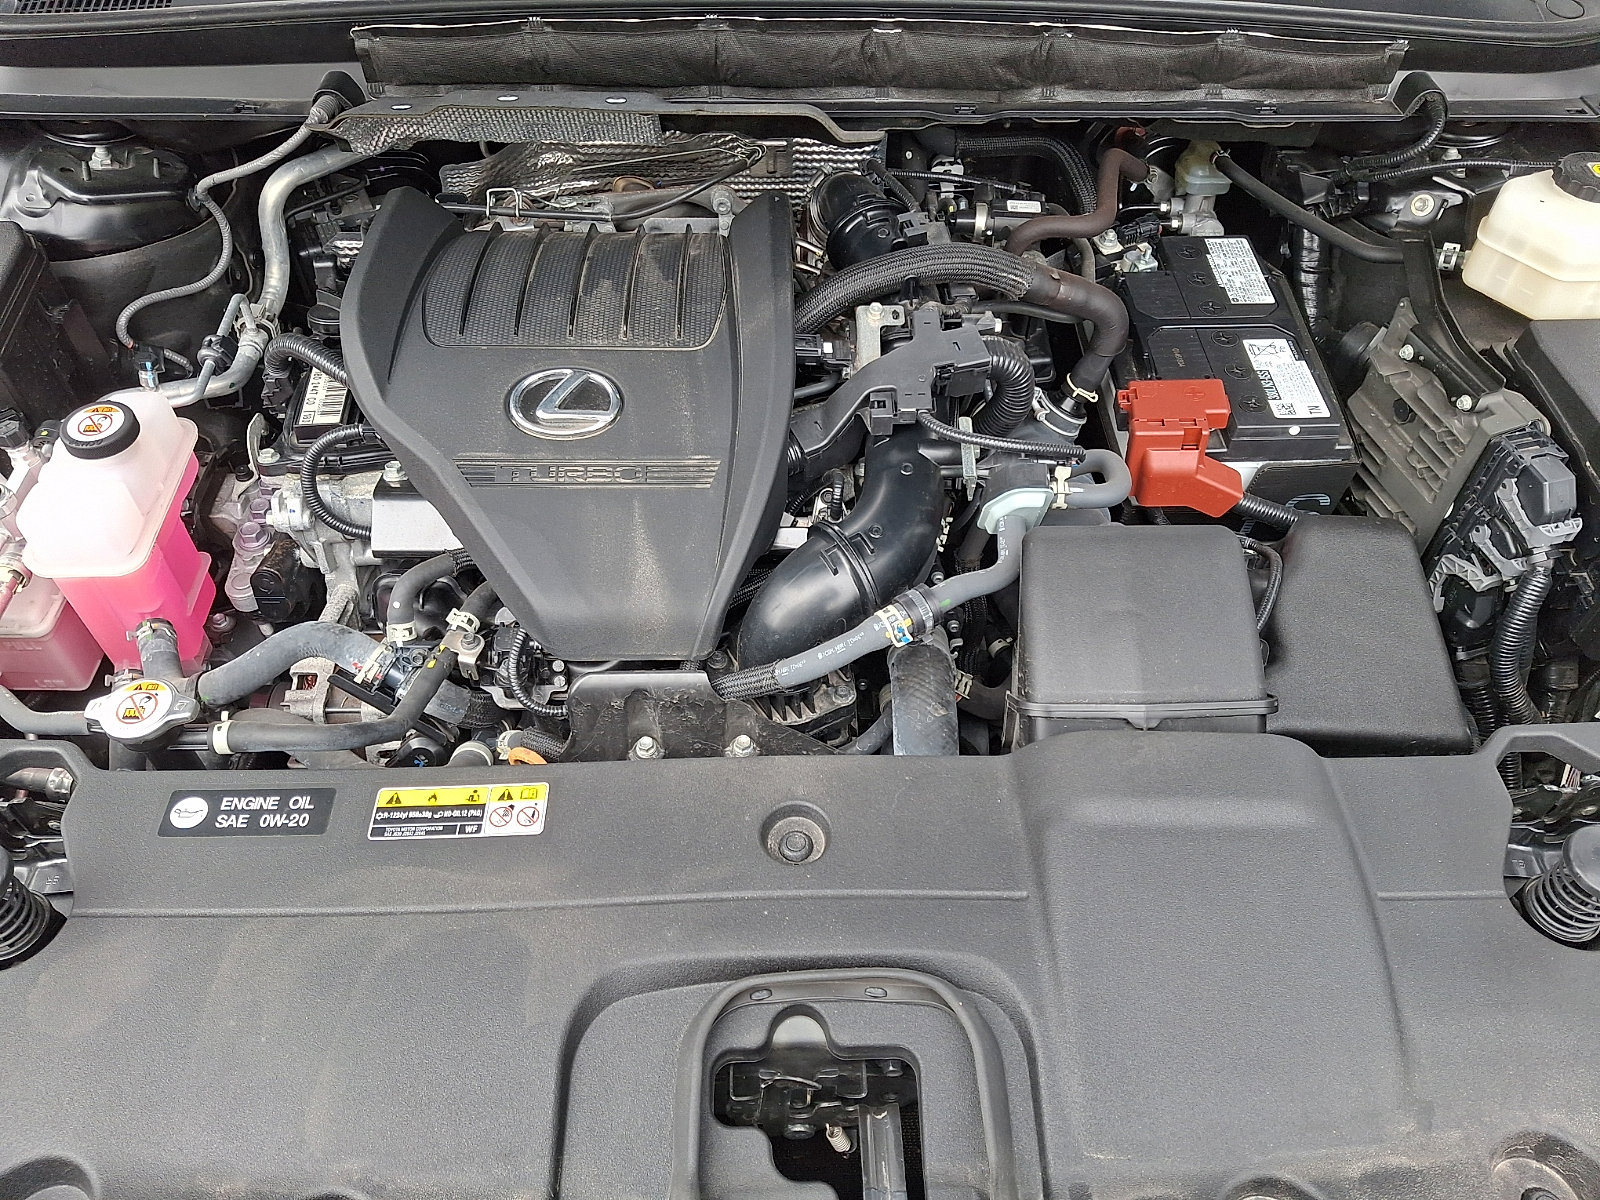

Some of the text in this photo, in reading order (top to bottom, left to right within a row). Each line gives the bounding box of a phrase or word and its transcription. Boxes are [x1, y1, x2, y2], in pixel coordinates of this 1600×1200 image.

[500, 465, 643, 483] TURBO
[220, 795, 315, 811] ENGINE OIL
[214, 813, 310, 828] SAE 0W-20
[465, 825, 478, 833] WF
